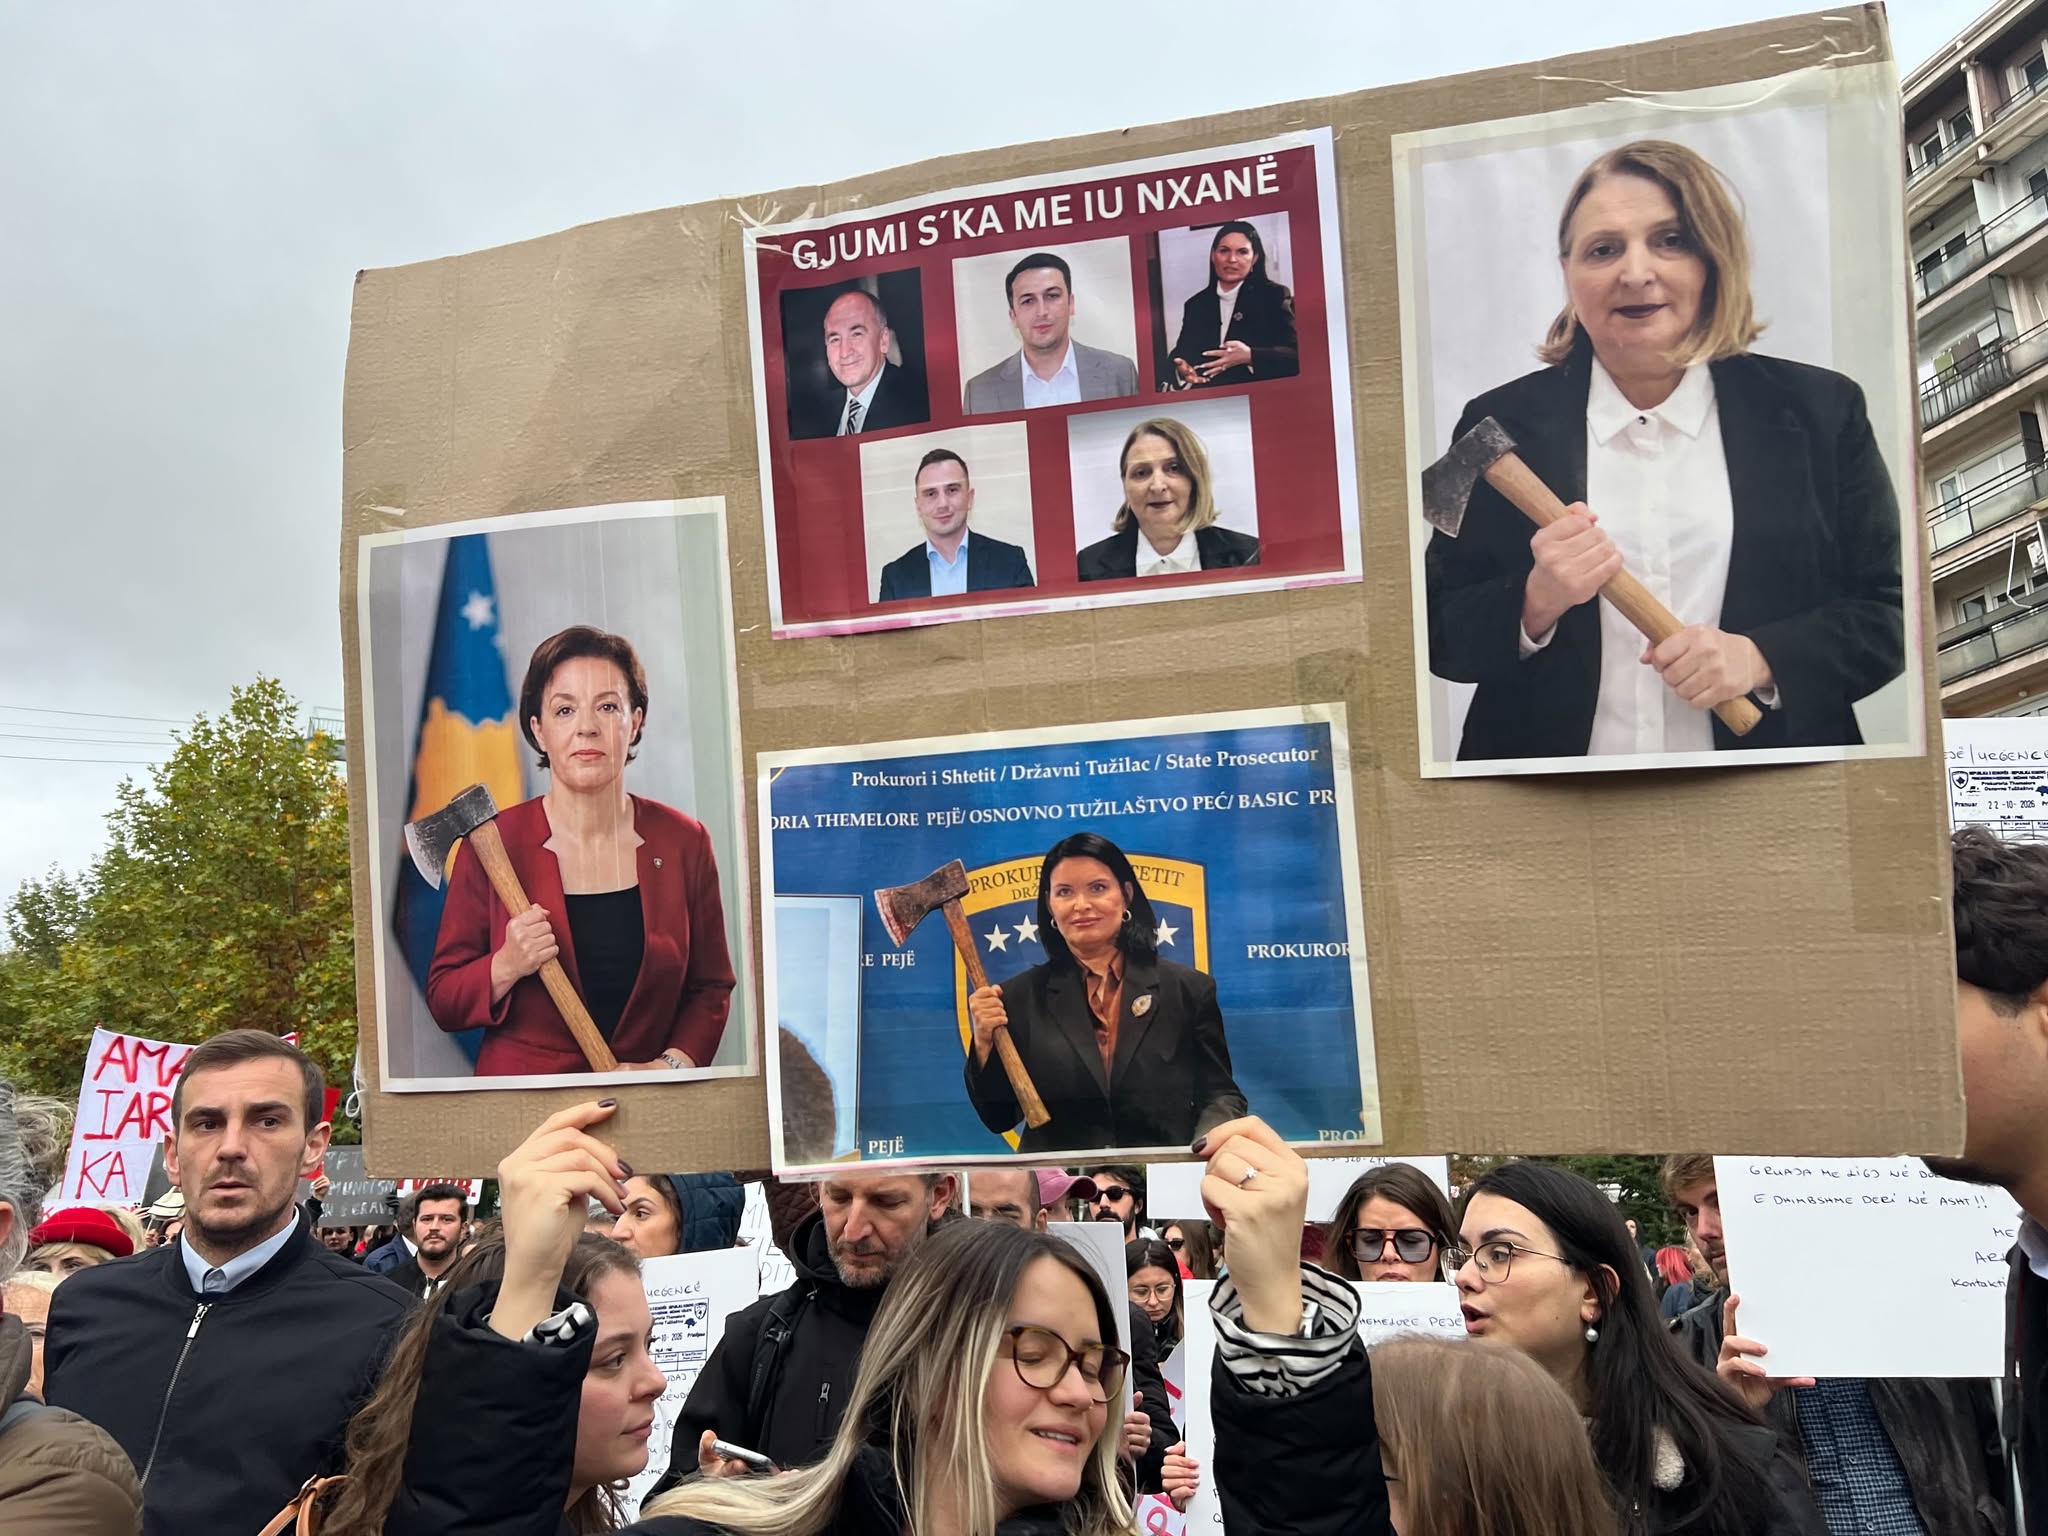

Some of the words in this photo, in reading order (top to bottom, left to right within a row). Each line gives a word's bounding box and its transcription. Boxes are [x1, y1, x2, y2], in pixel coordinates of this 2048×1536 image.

[792, 221, 908, 270] GJUMI
[1014, 194, 1073, 231] ME
[1084, 186, 1123, 222] IU
[1137, 154, 1280, 214] NXANË
[851, 771, 927, 787] Prokurori
[931, 770, 937, 785] i
[941, 767, 996, 784] Shtetit
[1000, 765, 1007, 782] /
[1011, 761, 1081, 780] Državni
[1085, 757, 1150, 776] Tužilac
[1154, 754, 1161, 771] /
[1166, 753, 1212, 770] State
[1216, 747, 1319, 767] Prosecutor
[814, 812, 919, 828] THEMELORE
[969, 805, 1062, 823] OSNOVNO
[1067, 795, 1187, 818] TUŽILAŠTVO
[1238, 791, 1299, 809] BASIC
[1308, 789, 1336, 805] PR
[881, 950, 916, 970] PEJË
[867, 1135, 904, 1158] PEJË
[75, 1150, 128, 1199] KA
[1919, 1170, 1942, 1178] DO
[1754, 1193, 1766, 1204] E
